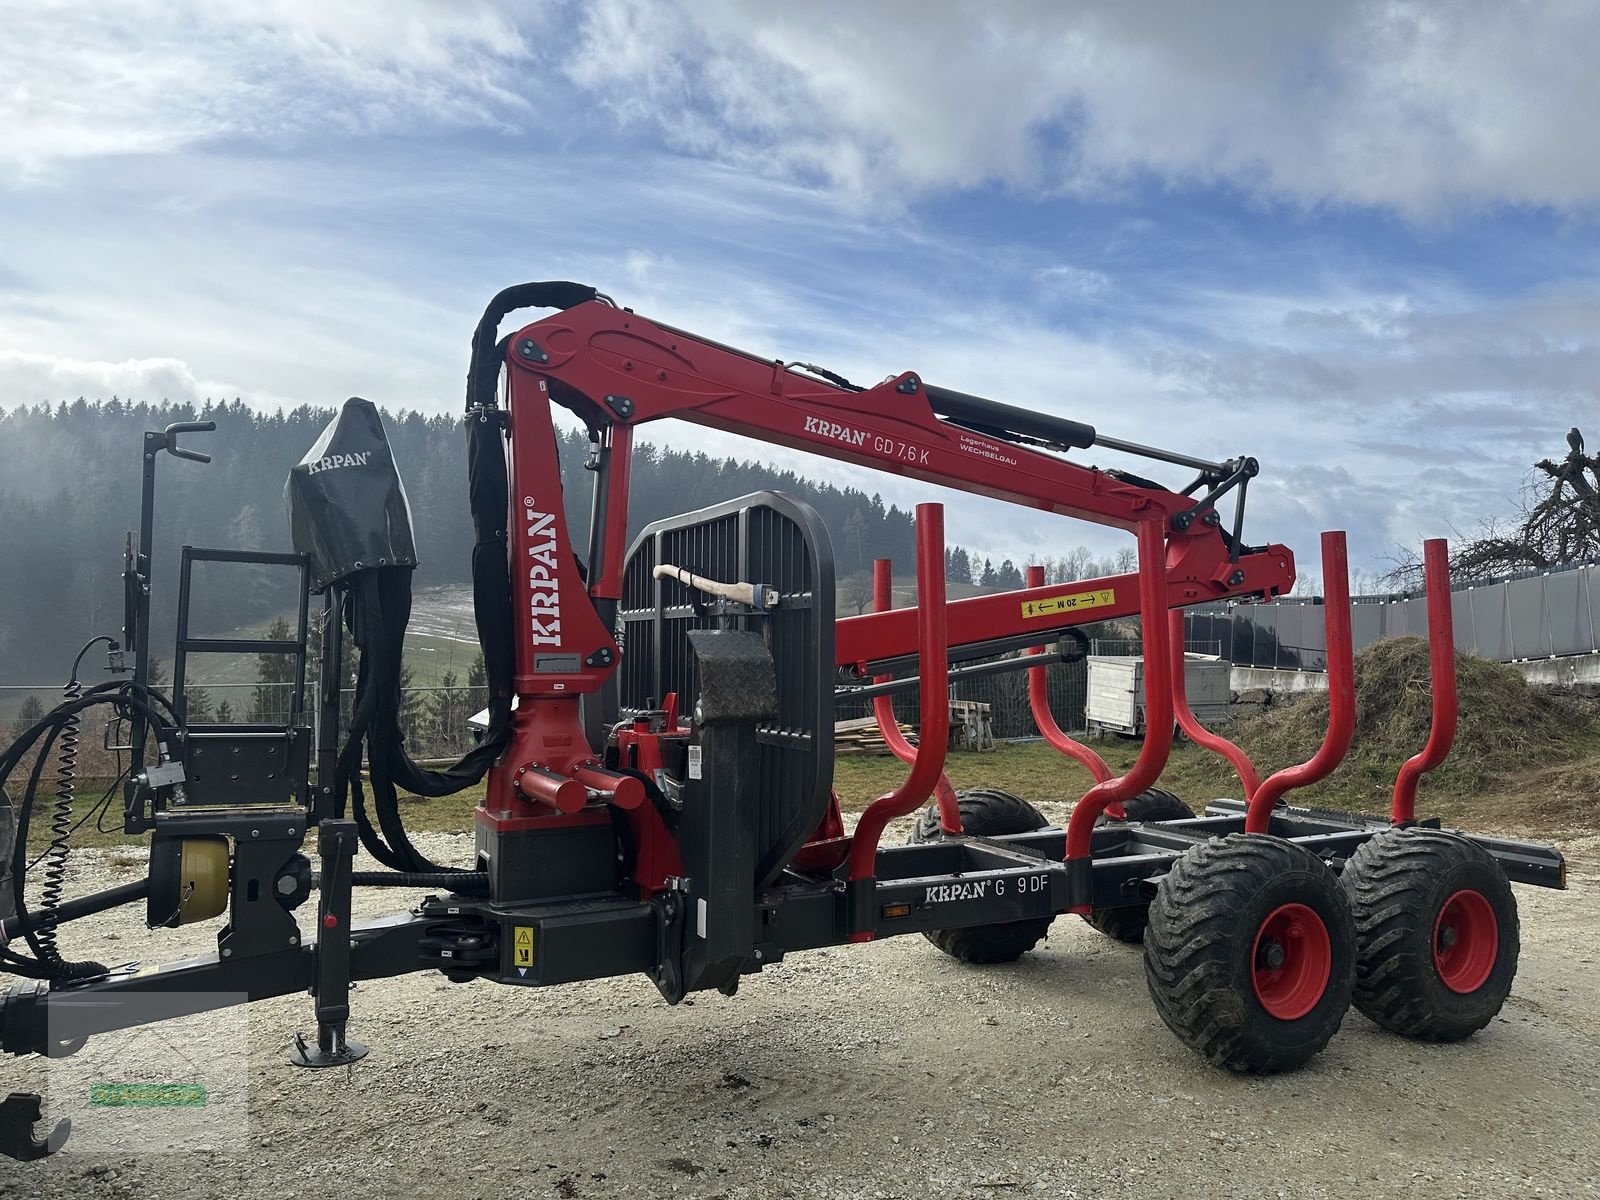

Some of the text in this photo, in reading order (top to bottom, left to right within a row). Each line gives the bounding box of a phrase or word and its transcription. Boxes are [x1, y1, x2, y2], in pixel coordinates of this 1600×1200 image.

[874, 436, 894, 454] GD
[898, 442, 916, 461] 7,6
[919, 451, 930, 465] K
[960, 435, 1000, 452] Lagerhaus
[959, 444, 1017, 466] WECHSELGAU
[1057, 598, 1077, 609] 20 M
[995, 880, 1005, 896] G
[1031, 874, 1048, 892] DF
